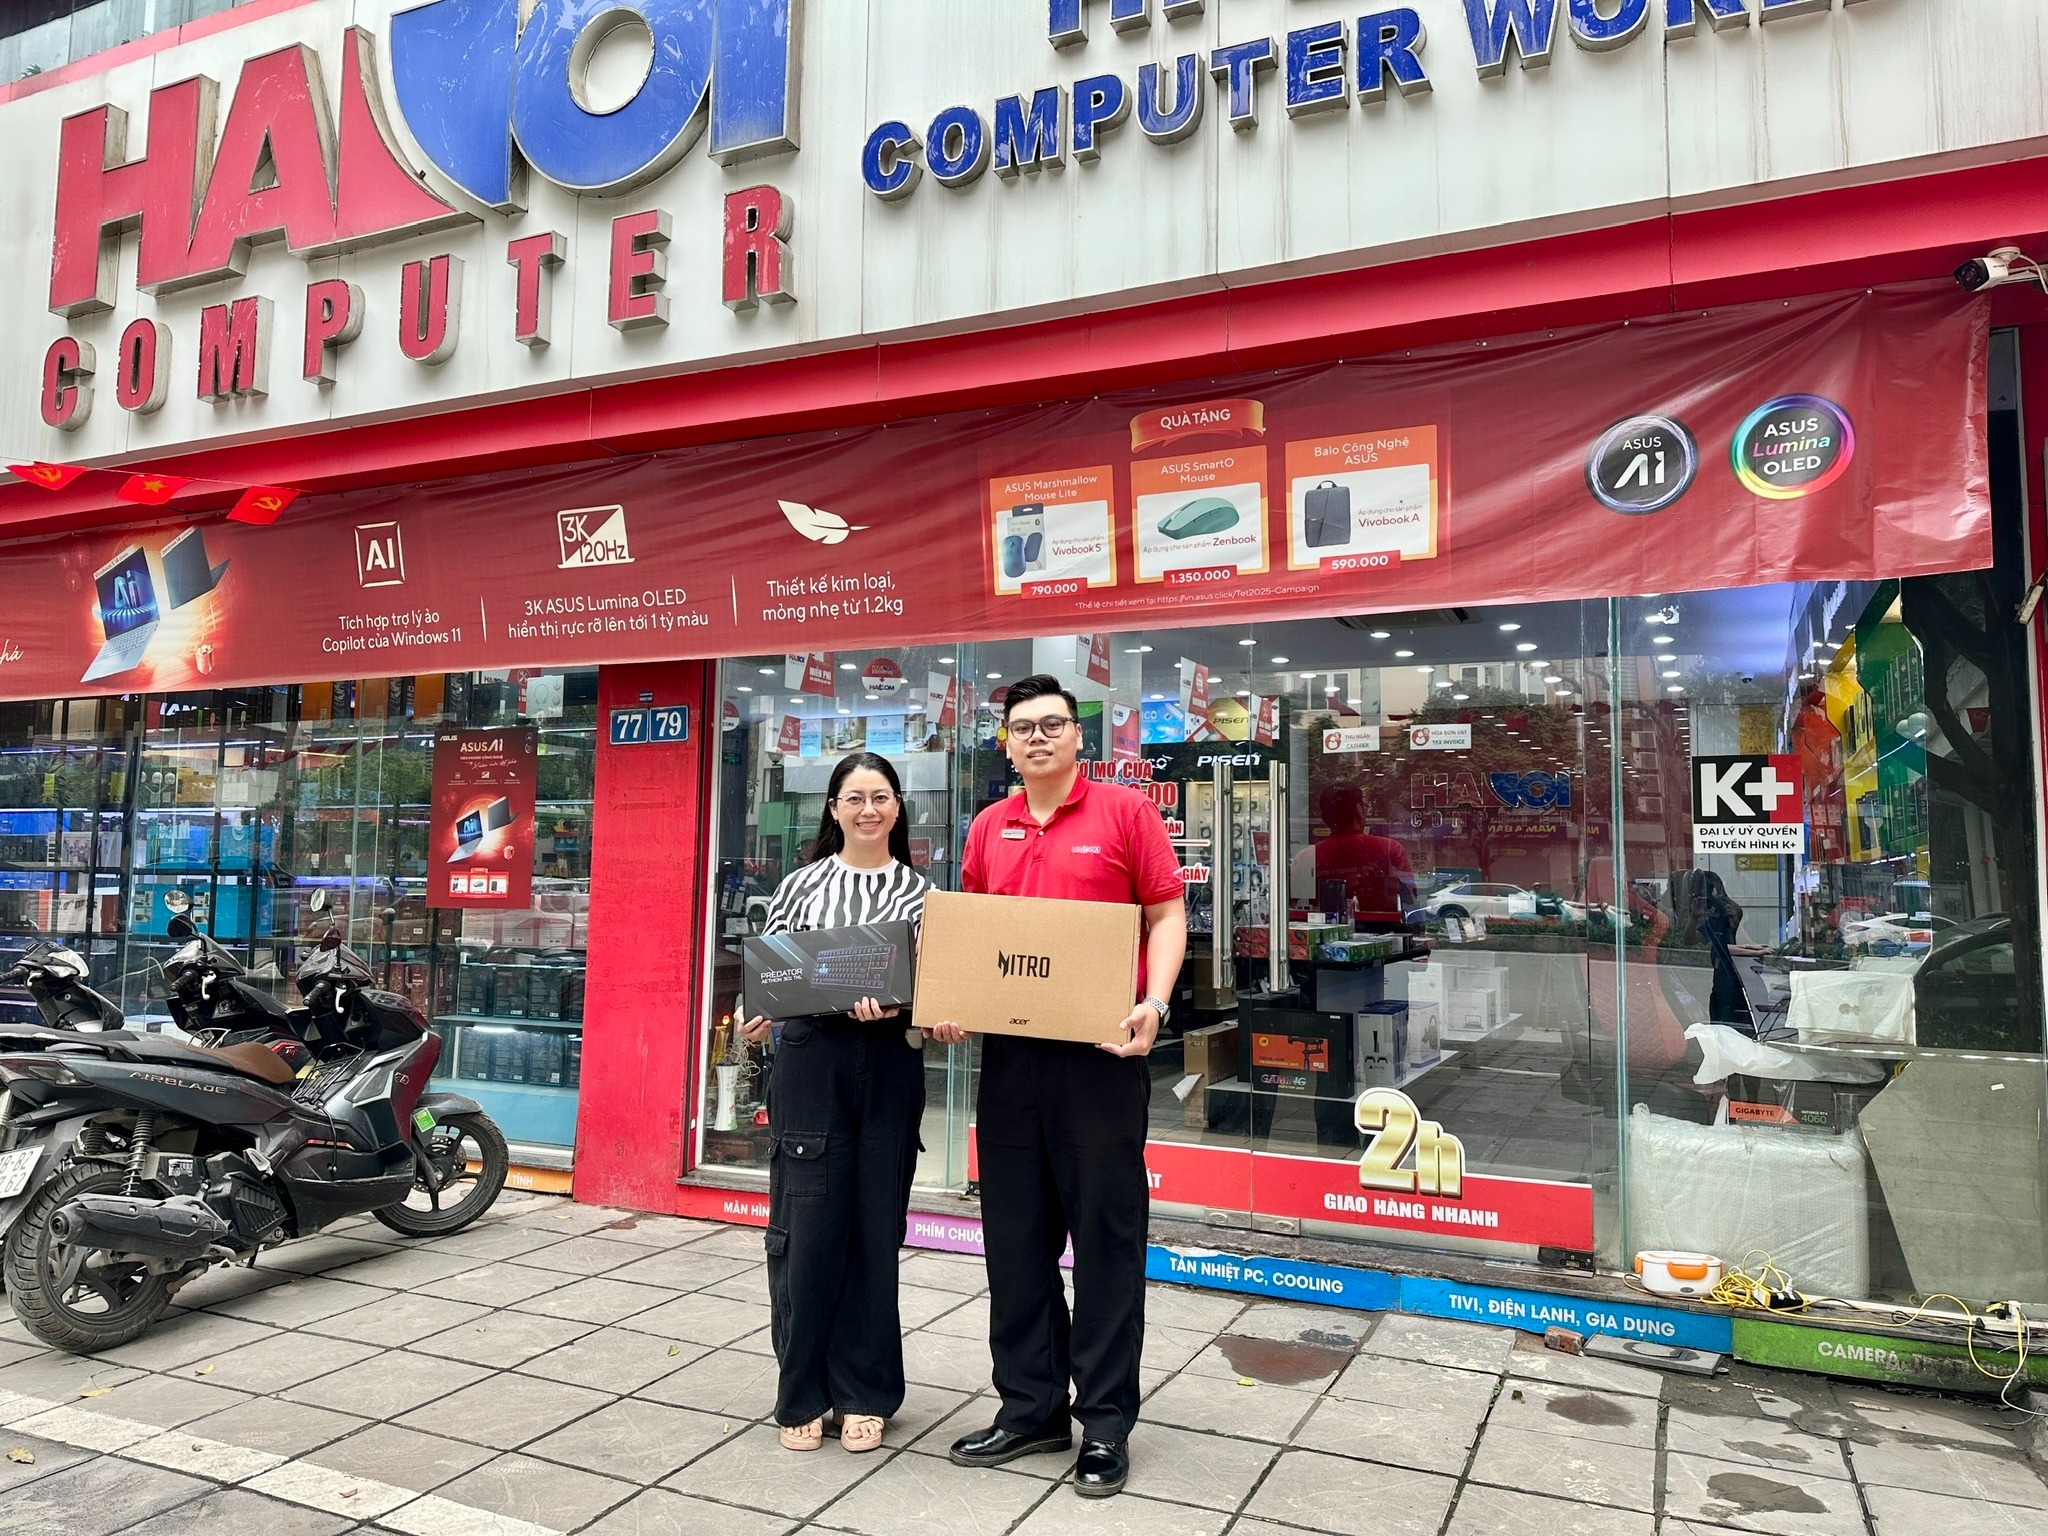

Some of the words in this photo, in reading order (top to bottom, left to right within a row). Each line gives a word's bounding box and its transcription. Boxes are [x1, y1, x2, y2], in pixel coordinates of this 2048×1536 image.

[861, 7, 1433, 201] COMPUTER
[41, 184, 796, 431] COMPUTER
[1160, 411, 1191, 430] QUÀ
[1192, 408, 1231, 427] TẶNG
[1763, 417, 1819, 438] ASUS
[1314, 446, 1340, 457] Balo
[1342, 443, 1374, 454] Công
[1377, 437, 1410, 449] Nghệ
[1622, 436, 1662, 450] ASUS
[1752, 436, 1831, 458] Lumina
[1344, 453, 1379, 465] ASUS
[1763, 455, 1822, 475] OLED
[1161, 465, 1190, 475] ASUS
[1180, 473, 1216, 484] Mouse
[1004, 482, 1031, 494] ASUS
[1033, 476, 1098, 490] Marshmallow
[1024, 491, 1057, 501] Mouse
[1059, 489, 1077, 498] Lite
[562, 514, 590, 543] 3K
[1358, 516, 1410, 527] Vivobook
[1411, 513, 1421, 522] A
[579, 539, 627, 563] 120Hz
[1052, 545, 1094, 556] Vivobook
[1095, 543, 1102, 552] S
[1213, 535, 1257, 547] Zenbook
[366, 538, 396, 571] AI
[1331, 555, 1389, 570] 590.000
[766, 577, 806, 598] Thiết
[809, 574, 828, 594] kế
[831, 575, 860, 592] kim
[863, 571, 896, 592] loại,
[1171, 569, 1231, 584] 1.350.000
[1031, 582, 1078, 596] 790.000
[525, 600, 544, 616] 3K
[546, 596, 584, 614] ASUS
[587, 594, 639, 611] Lumina
[642, 588, 687, 606] OLED
[762, 603, 806, 623] mỏng
[809, 600, 840, 620] nhẹ
[842, 598, 861, 615] từ
[863, 596, 904, 616] 1.2kg
[338, 614, 364, 630] Tích
[366, 614, 389, 632] hợp
[391, 612, 409, 629] trợ
[411, 609, 422, 628] lý
[425, 608, 440, 624] ảo
[508, 620, 537, 639] hiển
[540, 620, 559, 639] thị
[562, 621, 585, 638] rực
[588, 617, 602, 633] rỡ
[605, 616, 626, 632] lên
[629, 614, 648, 630] tới
[651, 613, 657, 628] 1
[660, 611, 673, 632] tỷ
[677, 610, 709, 627] màu
[322, 635, 365, 655] Copilot
[368, 632, 389, 649] của
[391, 631, 449, 647] Windows
[451, 627, 461, 642] 11
[617, 714, 642, 739] 77
[656, 711, 682, 737] 79
[1197, 753, 1261, 767] PISEN
[1411, 771, 1571, 808] HANOI
[1701, 762, 1794, 817] K+
[1699, 828, 1719, 837] ĐẠI
[1723, 826, 1735, 836] LÝ
[1750, 839, 1779, 849] HÌNH
[1782, 840, 1796, 849] K+
[761, 968, 803, 979] PREDATOR
[998, 949, 1050, 979] NITRO
[129, 1071, 228, 1094] AIRBLADE
[1260, 1073, 1307, 1086] GAMING
[1735, 1107, 1774, 1117] GIGABYTE
[1801, 1114, 1827, 1124] 4060
[1357, 1088, 1463, 1199] 2h
[512, 1172, 533, 1187] TÍNH
[723, 1199, 749, 1215] MÀN
[1324, 1193, 1368, 1213] GIAO
[1373, 1197, 1425, 1219] HÀNG
[1431, 1205, 1499, 1228] NHANH
[915, 1222, 945, 1238] PHÍM
[1201, 1262, 1240, 1282] NHIỆT
[1243, 1269, 1268, 1286] PC,
[1272, 1272, 1344, 1294] COOLING
[1449, 1294, 1483, 1315] TIVI,
[1488, 1298, 1526, 1319] ĐIỆN
[1530, 1304, 1580, 1326] LẠNH,
[1585, 1312, 1618, 1329] GIA
[1623, 1316, 1676, 1337] DỤNG
[1817, 1341, 1901, 1371] CAMERA
